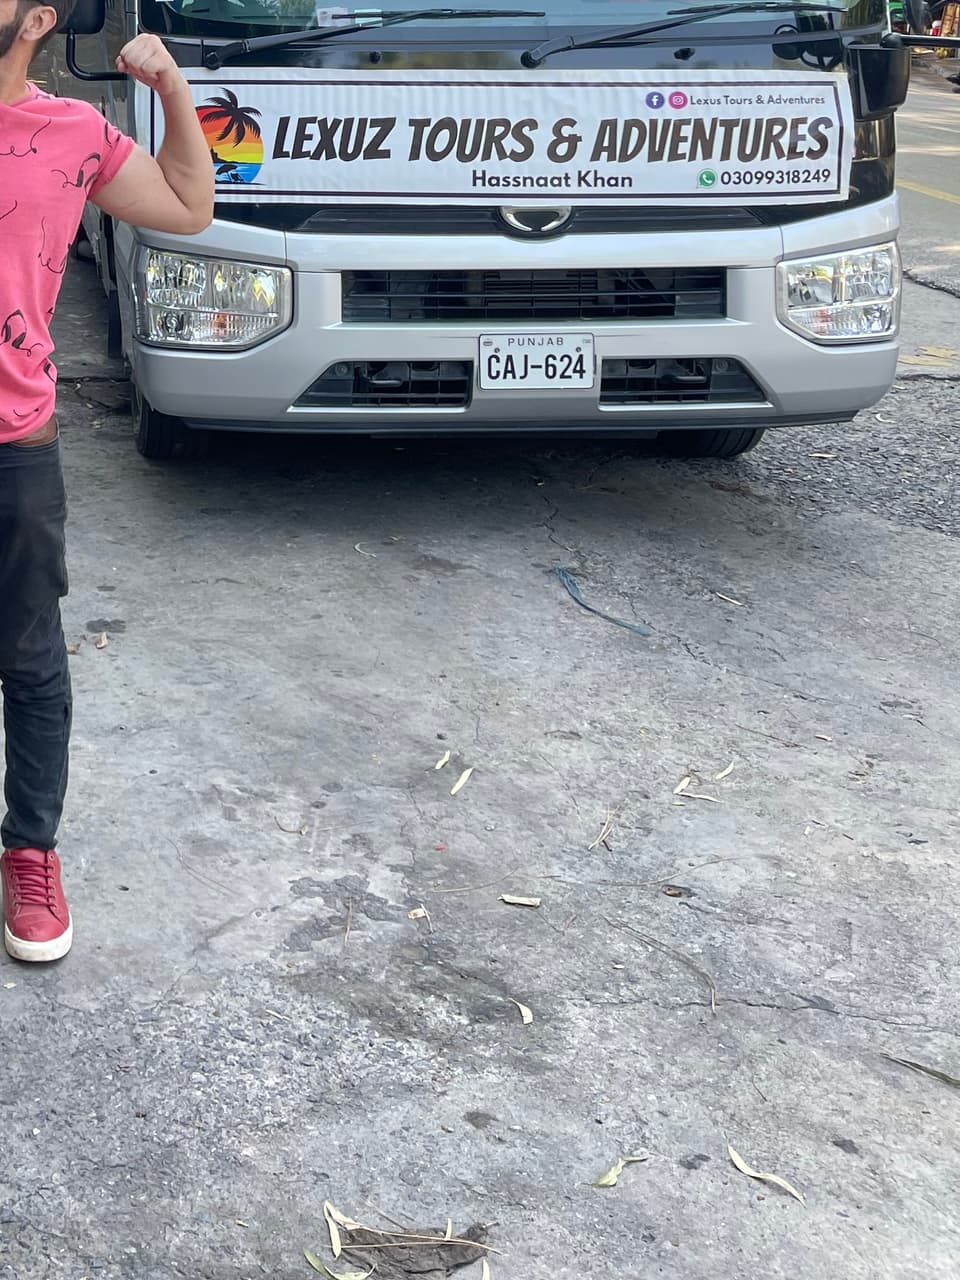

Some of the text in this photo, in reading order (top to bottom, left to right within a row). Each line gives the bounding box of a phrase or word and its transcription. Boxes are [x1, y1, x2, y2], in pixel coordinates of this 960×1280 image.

[690, 94, 825, 106] Lexus Tours & Adventures
[272, 116, 833, 163] LEXUZ TOURS & ADVENTURES
[472, 170, 633, 188] Hassnaat Khan
[721, 169, 831, 187] 03099318249
[507, 337, 564, 347] PUNJAB
[487, 353, 587, 380] CAJ-624
